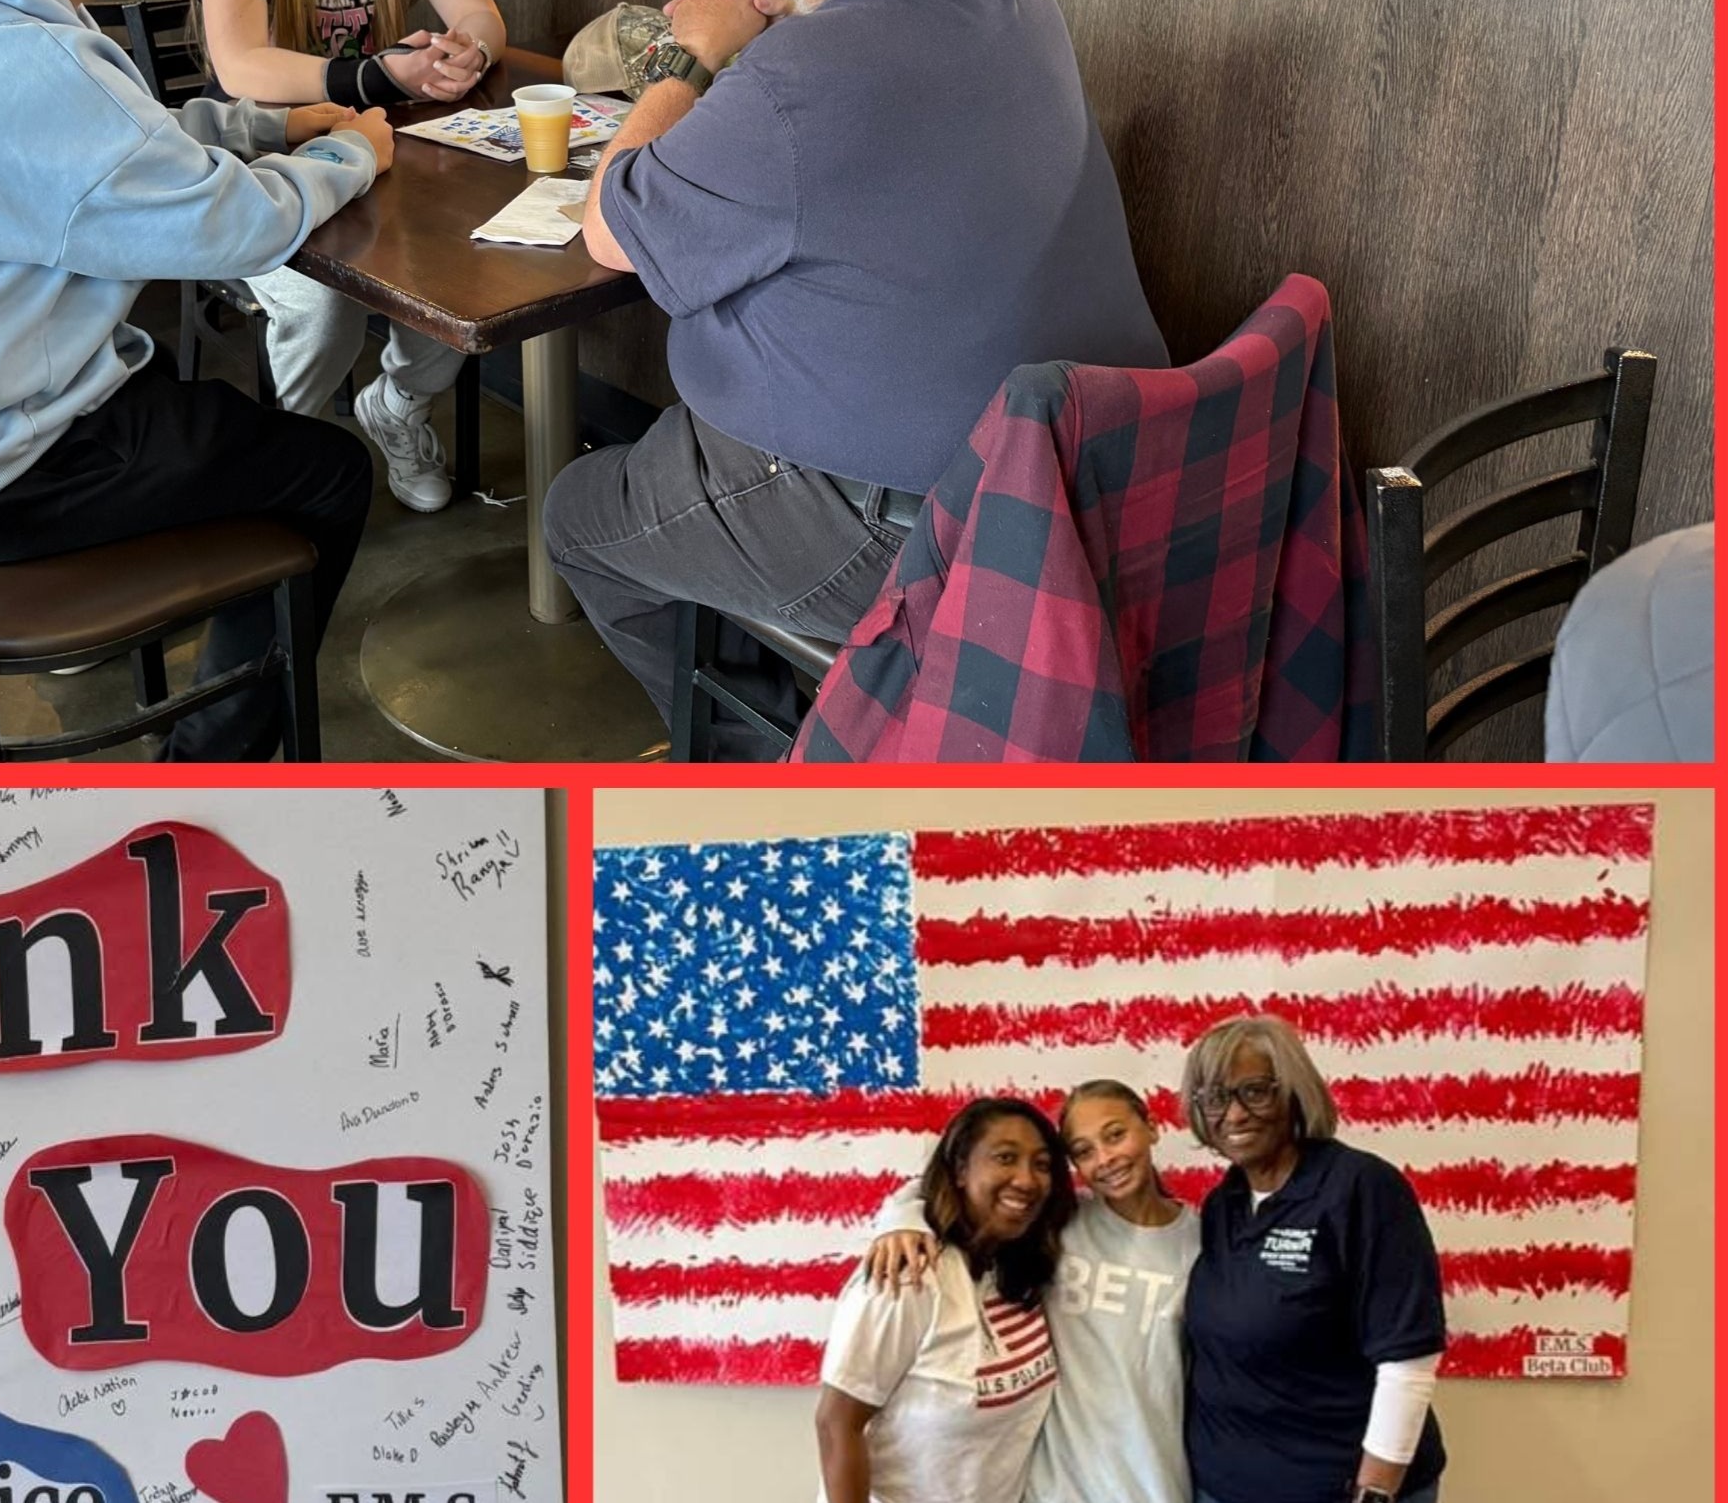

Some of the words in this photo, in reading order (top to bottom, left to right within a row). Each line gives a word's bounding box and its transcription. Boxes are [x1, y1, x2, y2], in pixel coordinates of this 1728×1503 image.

[369, 1025, 390, 1068] Maria
[493, 1117, 521, 1164] Josh
[28, 1159, 466, 1344] You
[1058, 1254, 1178, 1336] BET
[476, 1330, 522, 1402] Andrew
[1527, 1358, 1567, 1374] Beta
[1571, 1358, 1611, 1374] Club
